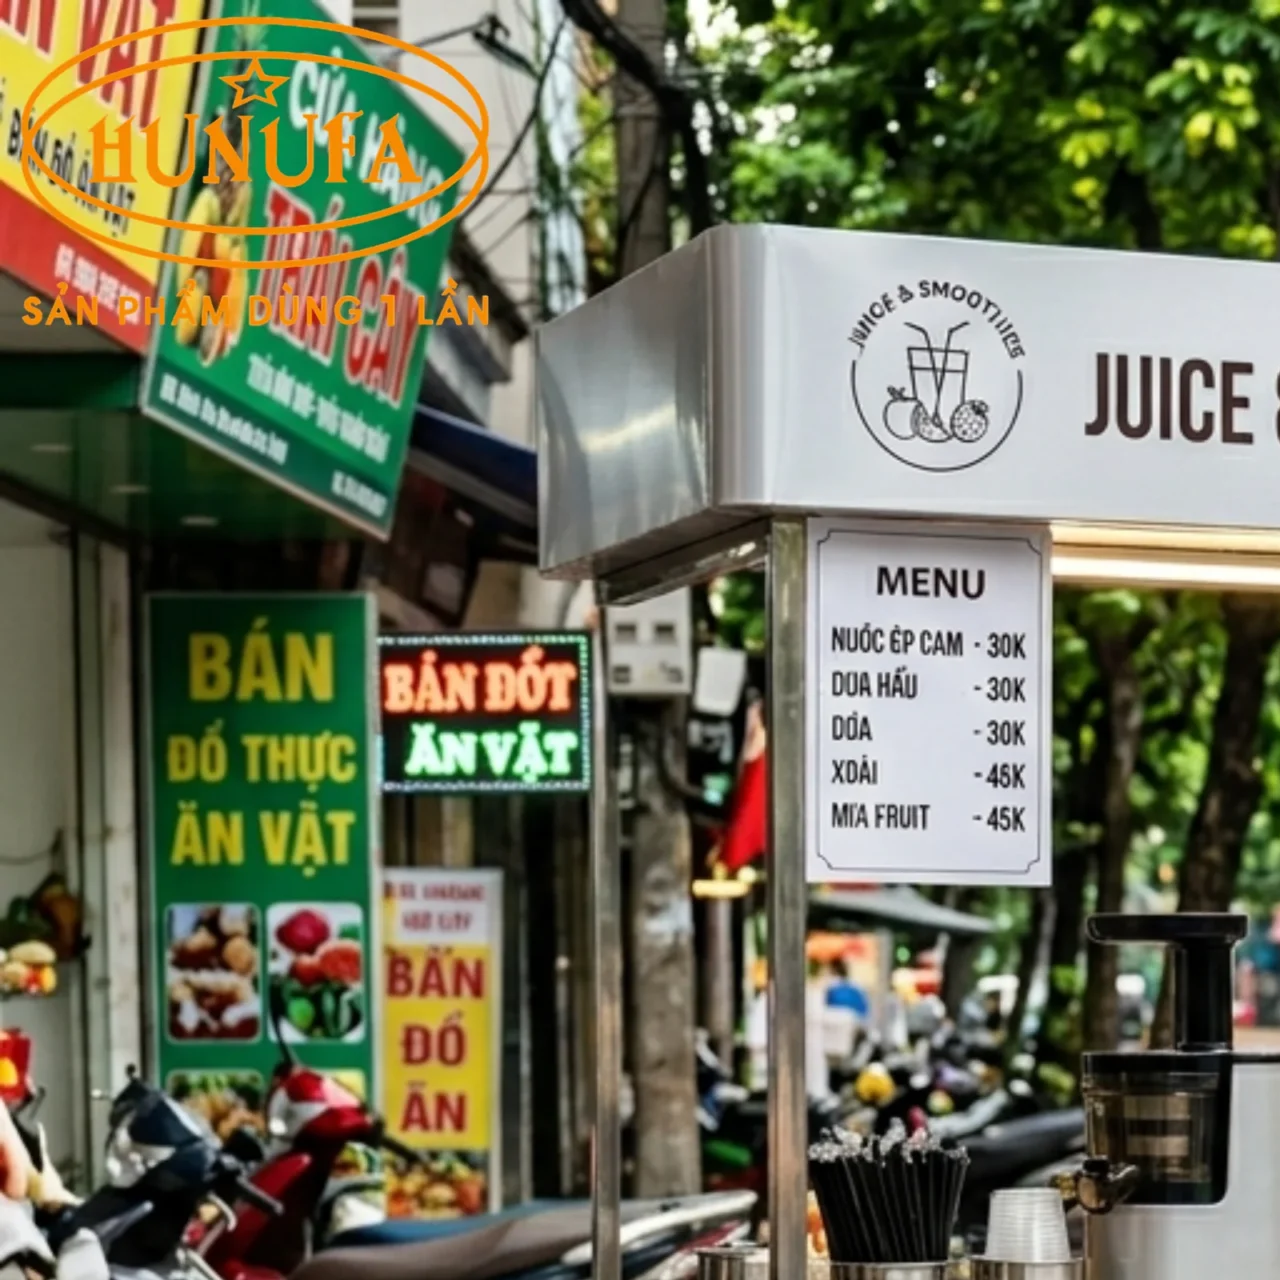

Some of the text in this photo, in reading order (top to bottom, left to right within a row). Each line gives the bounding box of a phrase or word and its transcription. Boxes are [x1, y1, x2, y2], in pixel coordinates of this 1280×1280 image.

[1085, 351, 1254, 444] JUICE
[876, 565, 986, 600] MENU
[189, 615, 335, 702] BÁN
[919, 628, 964, 657] CAM
[986, 632, 1027, 660] 30K
[986, 676, 1027, 703] 30K
[986, 719, 1026, 747] 30K
[874, 803, 931, 831] FRUIT
[986, 805, 1027, 833] 45K
